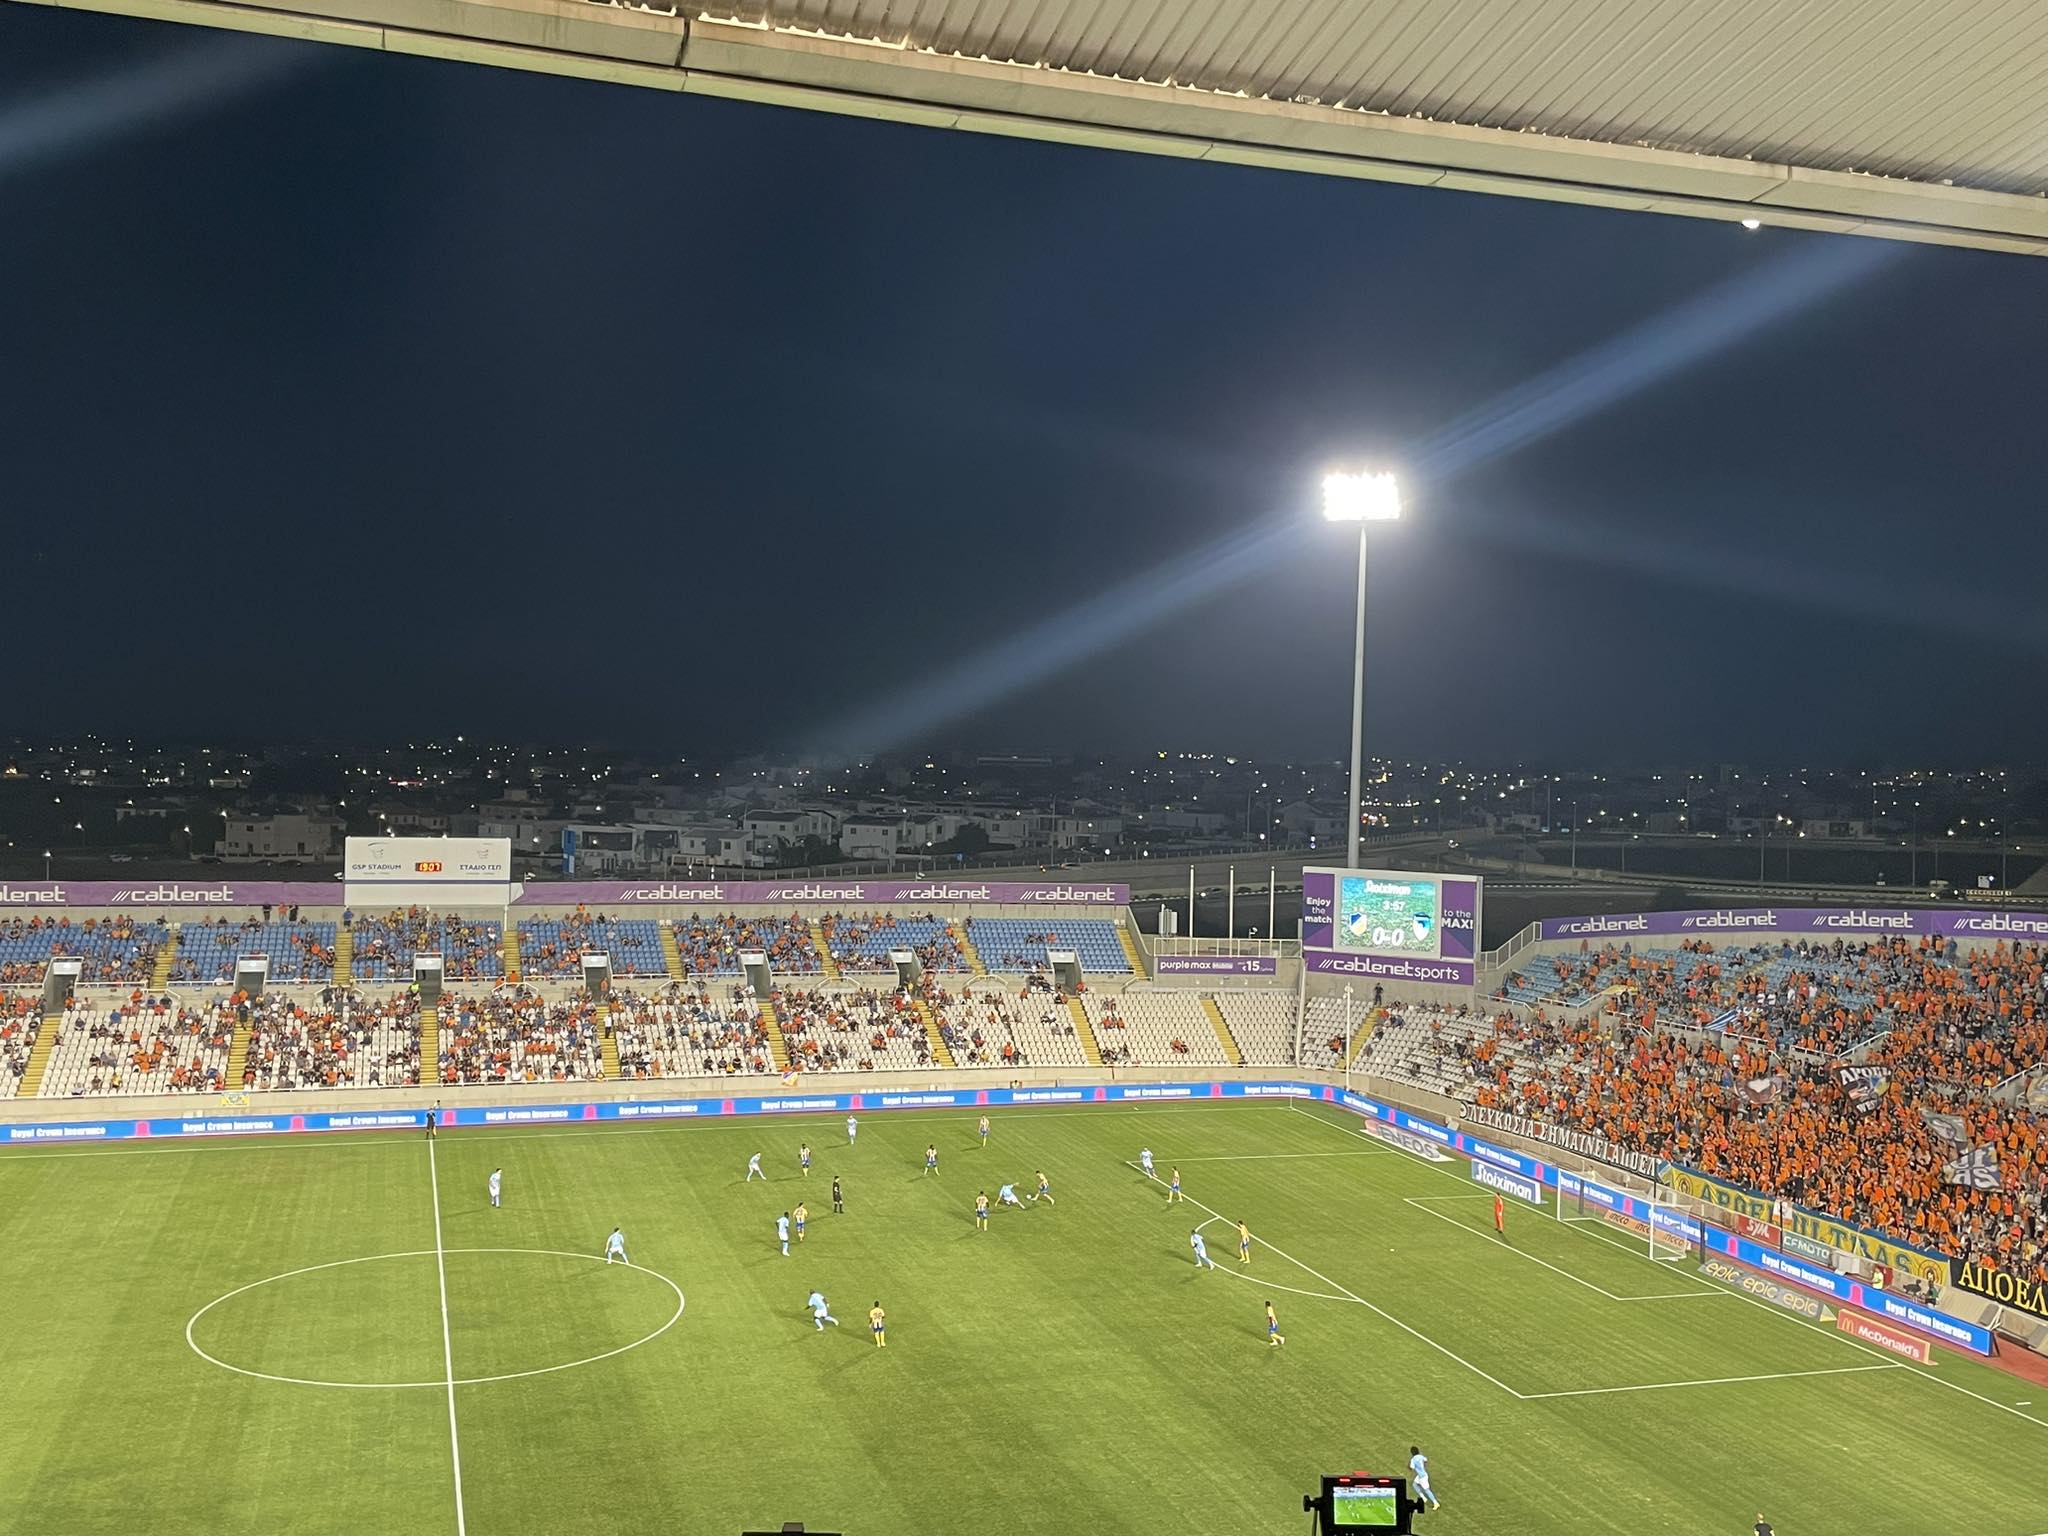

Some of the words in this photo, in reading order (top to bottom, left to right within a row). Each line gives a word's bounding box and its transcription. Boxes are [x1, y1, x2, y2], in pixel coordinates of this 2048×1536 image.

[0, 885, 66, 902] lenet
[131, 885, 234, 902] cablenet
[636, 884, 724, 900] cablenet
[781, 884, 865, 900] cablenet
[910, 884, 991, 900] cablenet
[1035, 886, 1115, 901] cablenet
[1306, 897, 1332, 907] Enjoy
[1311, 906, 1326, 915] the
[1304, 915, 1333, 924] match
[1444, 909, 1454, 917] to
[1456, 909, 1472, 919] the
[1695, 910, 1777, 928] cablenet
[1827, 910, 1914, 929] cablenet
[1441, 918, 1474, 930] MAX!
[1570, 914, 1648, 933] cablenet
[1160, 961, 1190, 970] purple
[1190, 961, 1211, 969] max
[1377, 1124, 1441, 1159] ENEOS
[1475, 1163, 1532, 1202] Stoiximan
[1706, 1261, 1740, 1283] epic
[1743, 1276, 1777, 1300] epic
[1958, 1261, 2048, 1316] ΑΠΟΕΛ
[1783, 1292, 1818, 1316] epic
[1857, 1325, 1921, 1359] McDonald's
